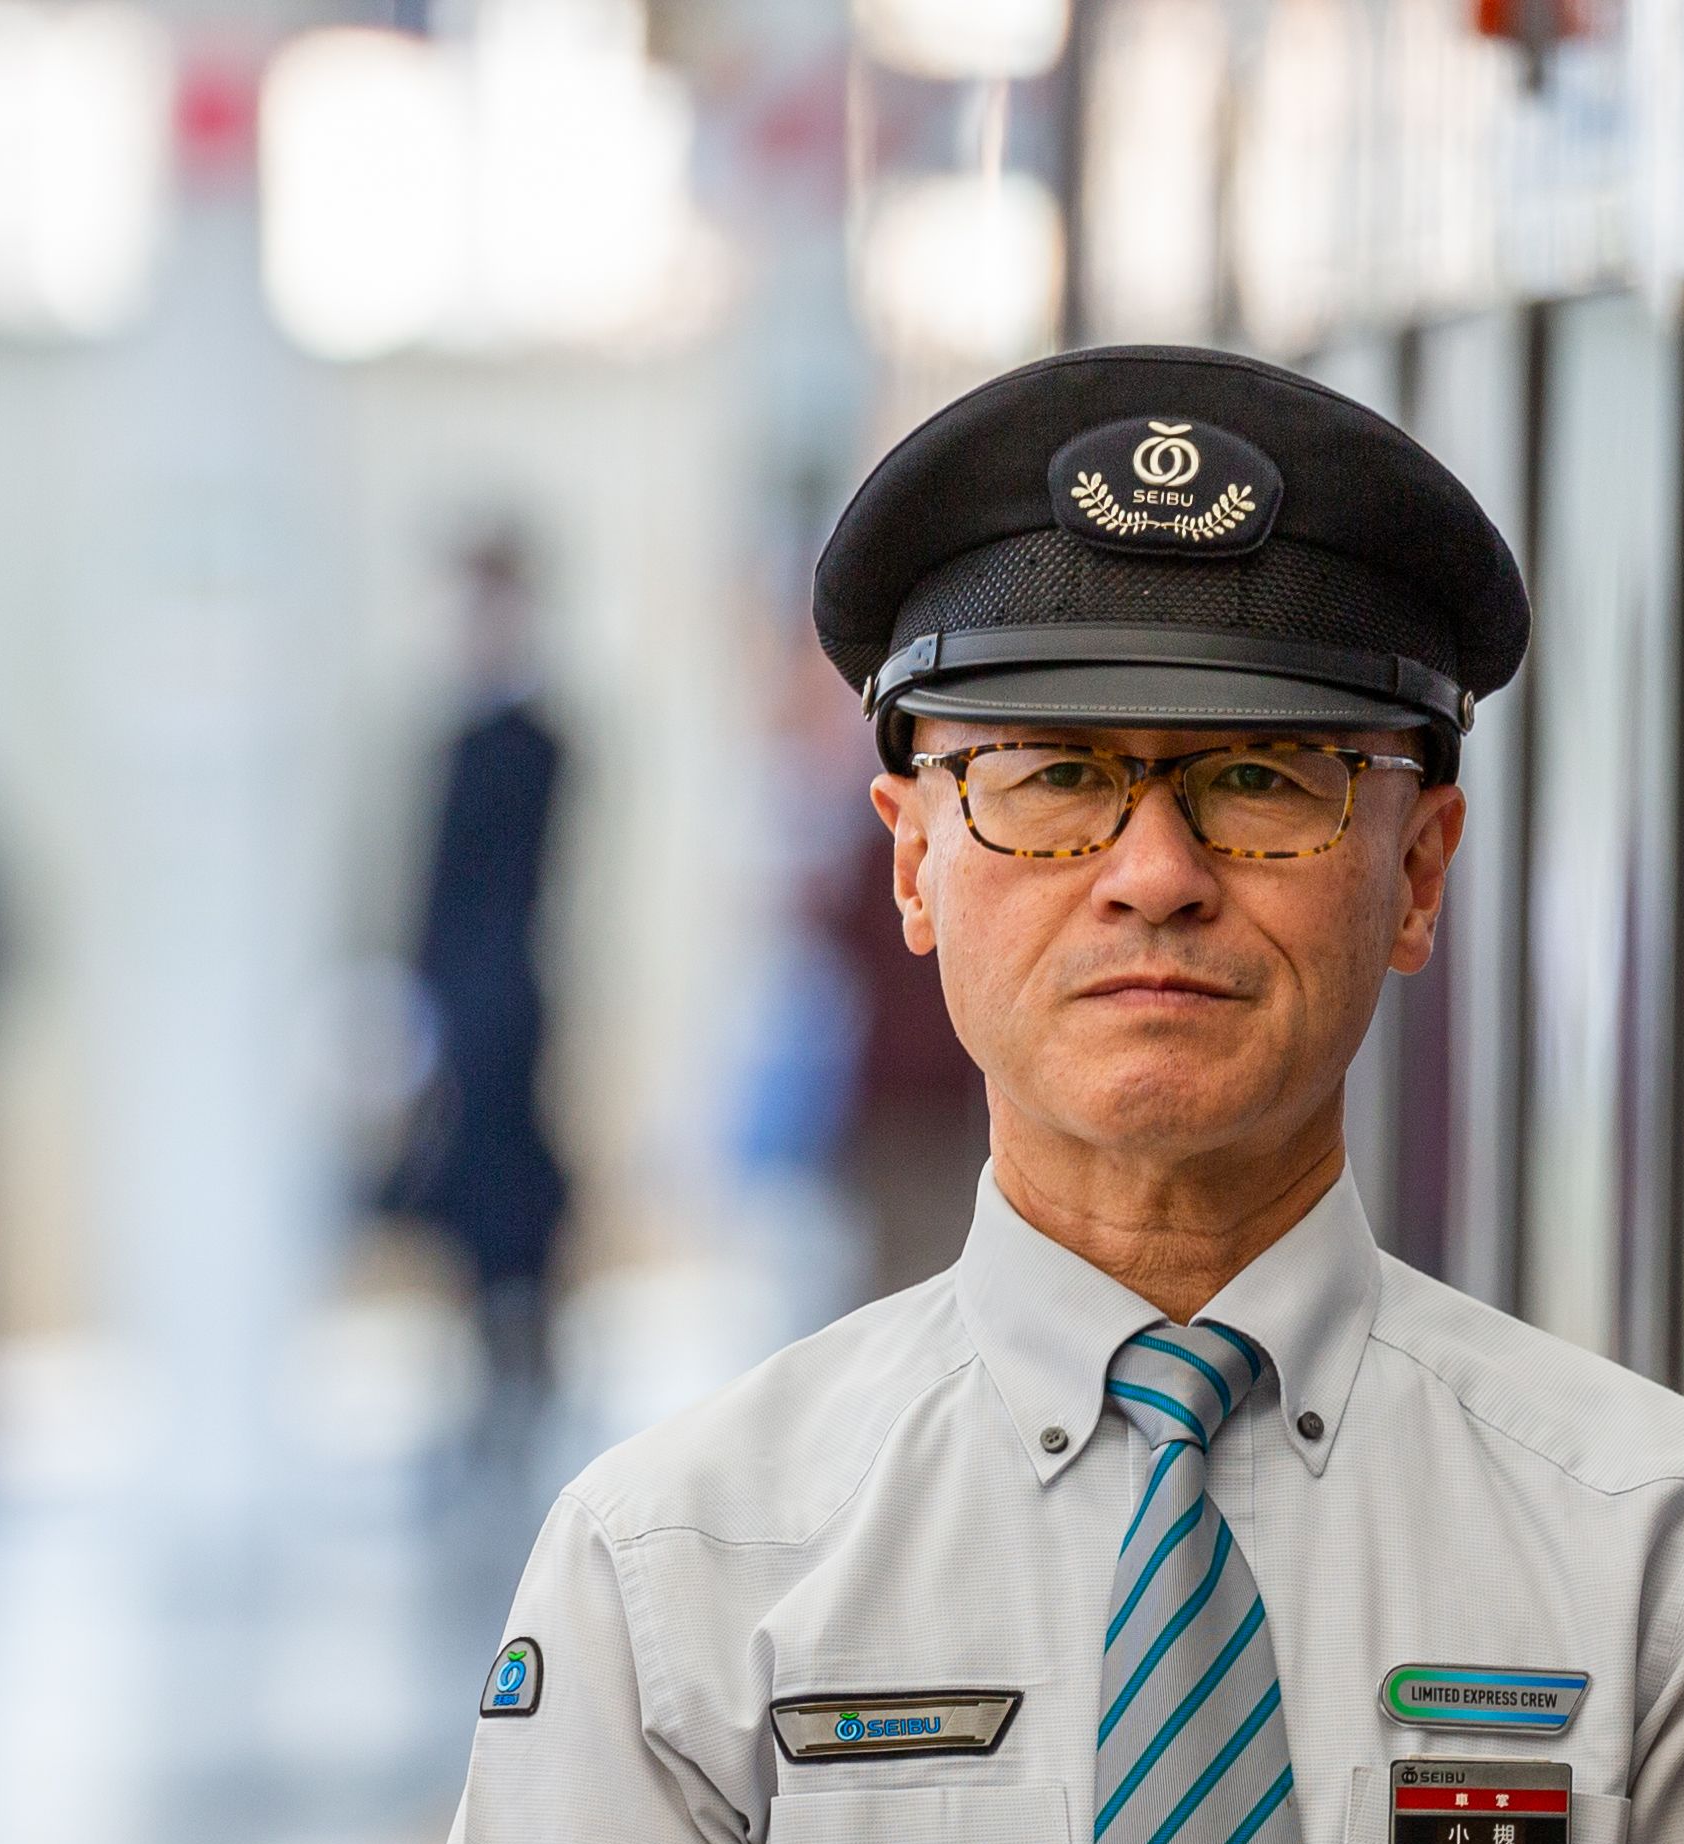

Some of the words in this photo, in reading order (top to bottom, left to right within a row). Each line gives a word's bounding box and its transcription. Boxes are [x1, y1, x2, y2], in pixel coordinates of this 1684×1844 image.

[1132, 489, 1194, 508] SEIBU
[1411, 1686, 1460, 1703] LIMITED
[1463, 1689, 1517, 1706] EXPRESS
[1521, 1692, 1558, 1708] CREW
[866, 1716, 941, 1738] SEIBU
[1420, 1771, 1465, 1784] SEIBU
